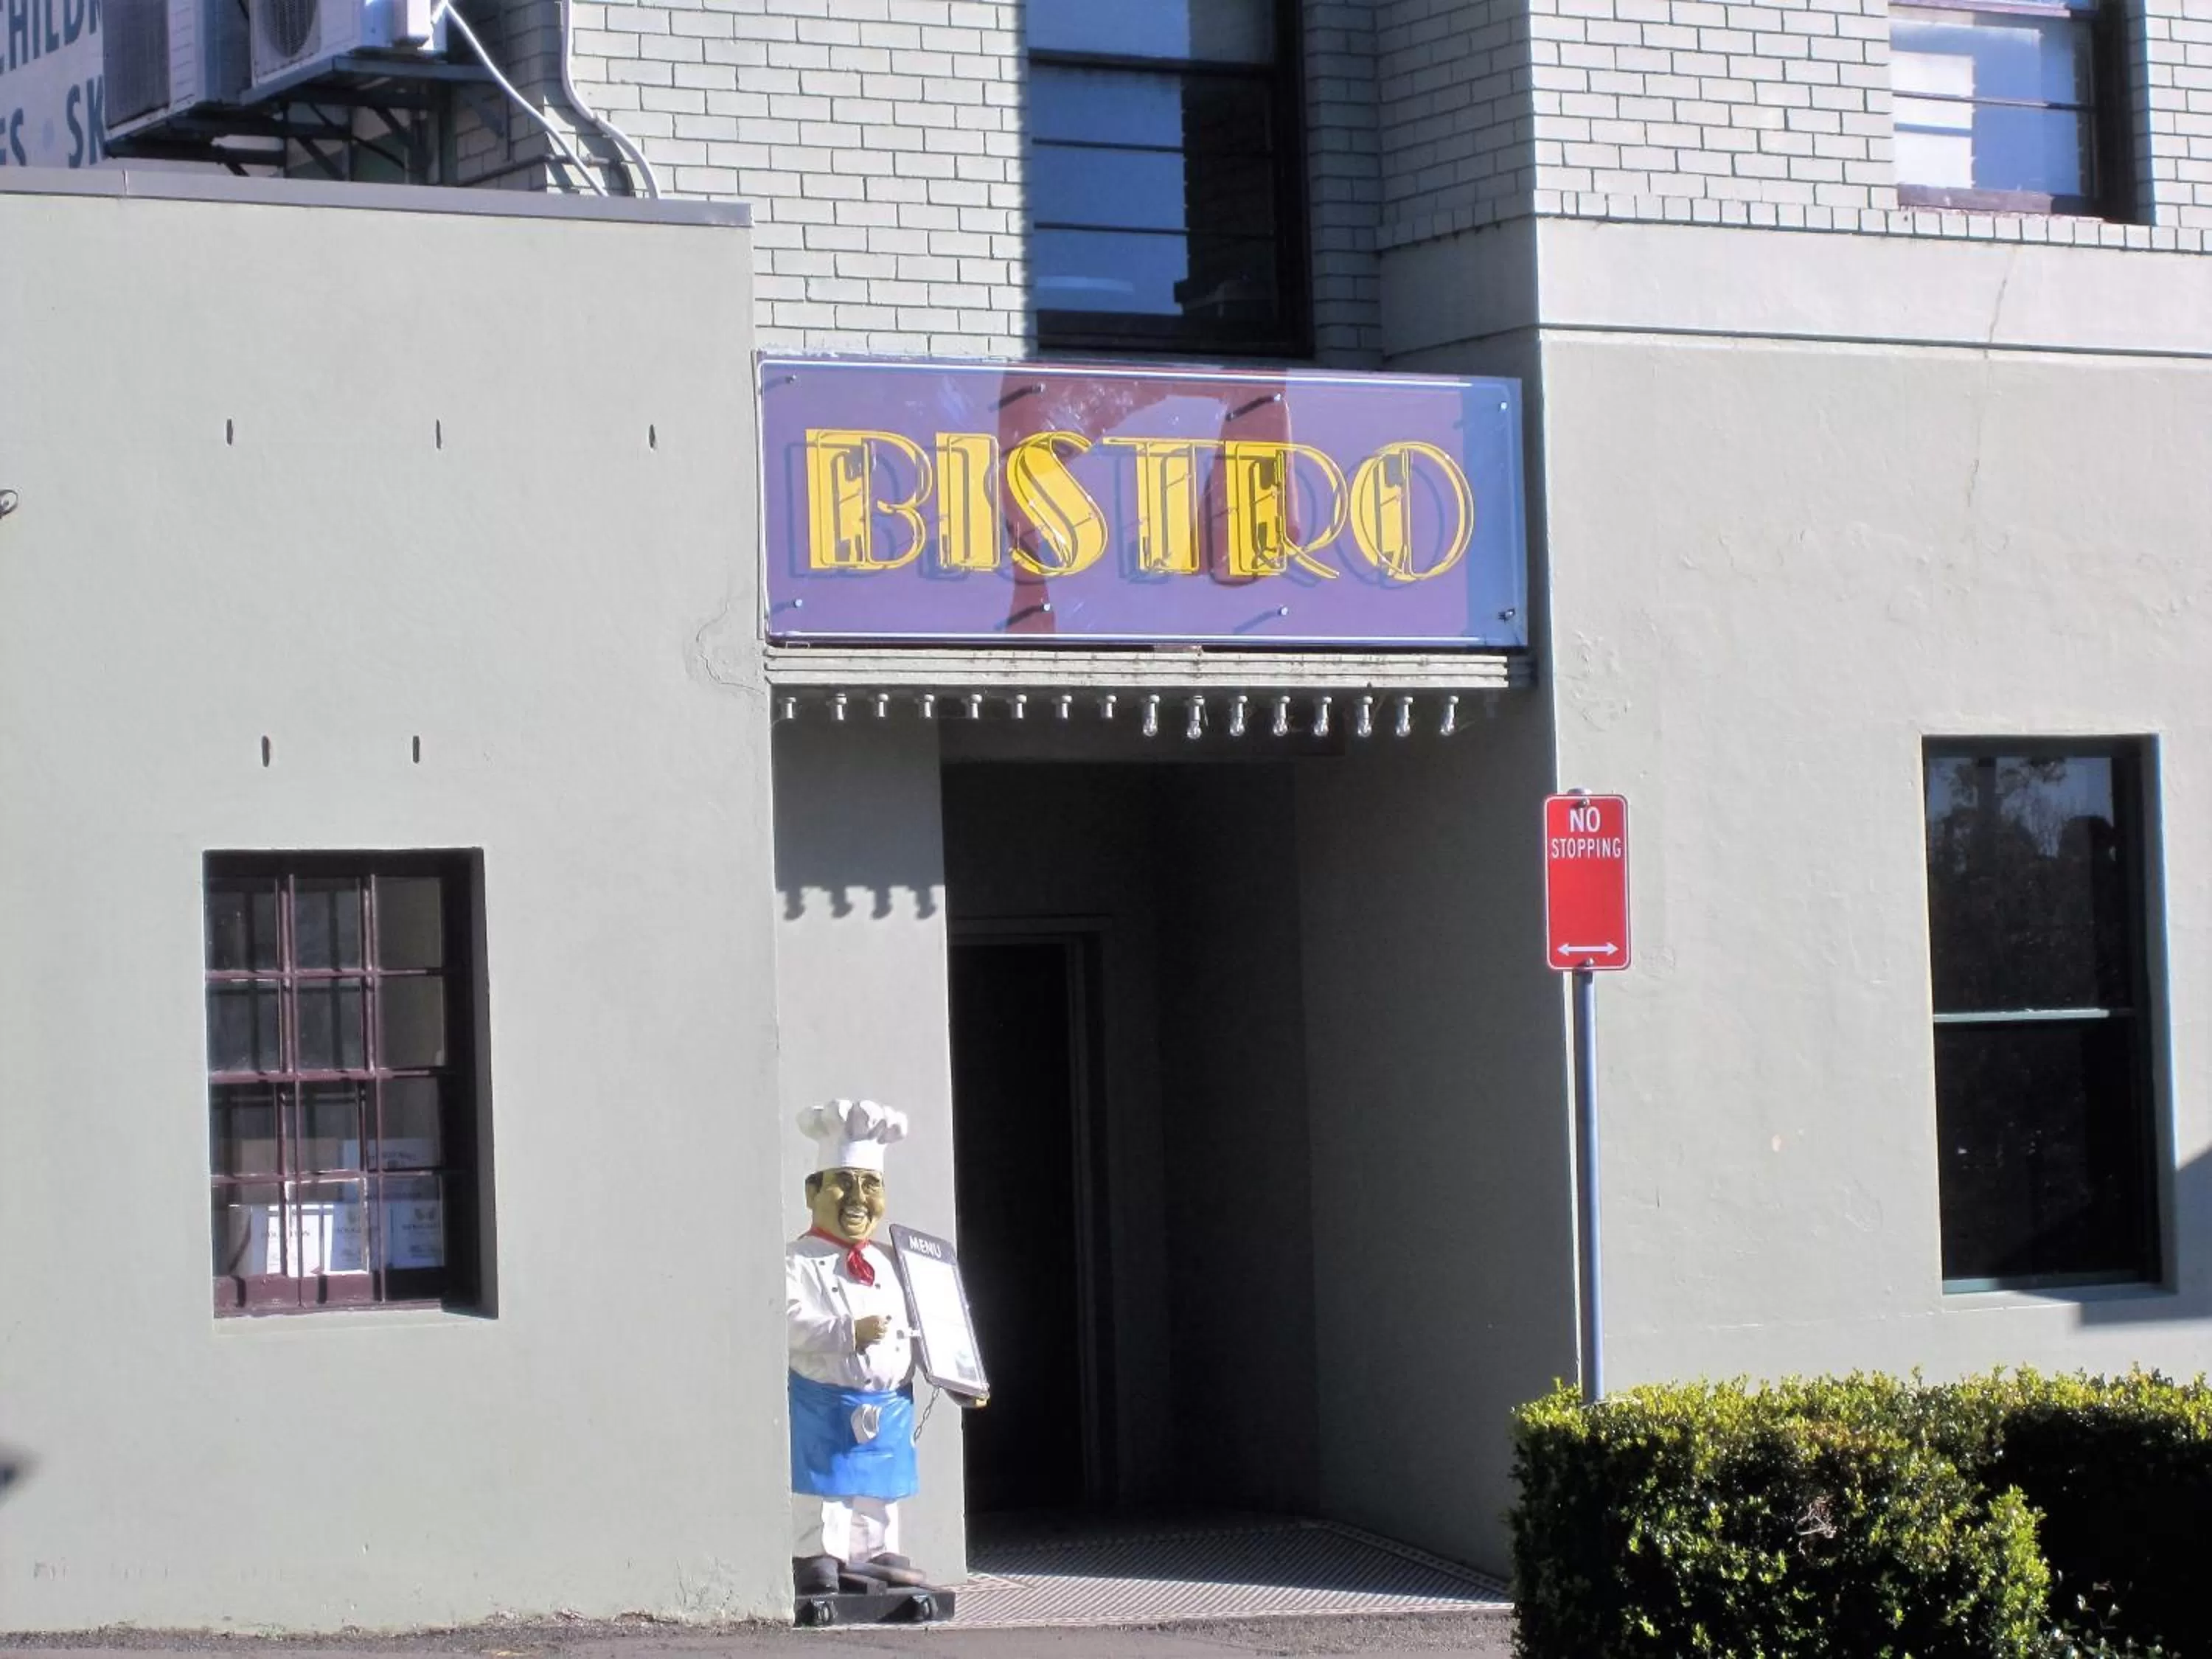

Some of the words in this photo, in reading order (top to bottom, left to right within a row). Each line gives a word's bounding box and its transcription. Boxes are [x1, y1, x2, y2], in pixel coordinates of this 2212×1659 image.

[805, 428, 1474, 582] BISTRO
[1570, 806, 1601, 832] NO
[1551, 838, 1621, 859] STOPPING
[908, 1235, 942, 1258] MENU
